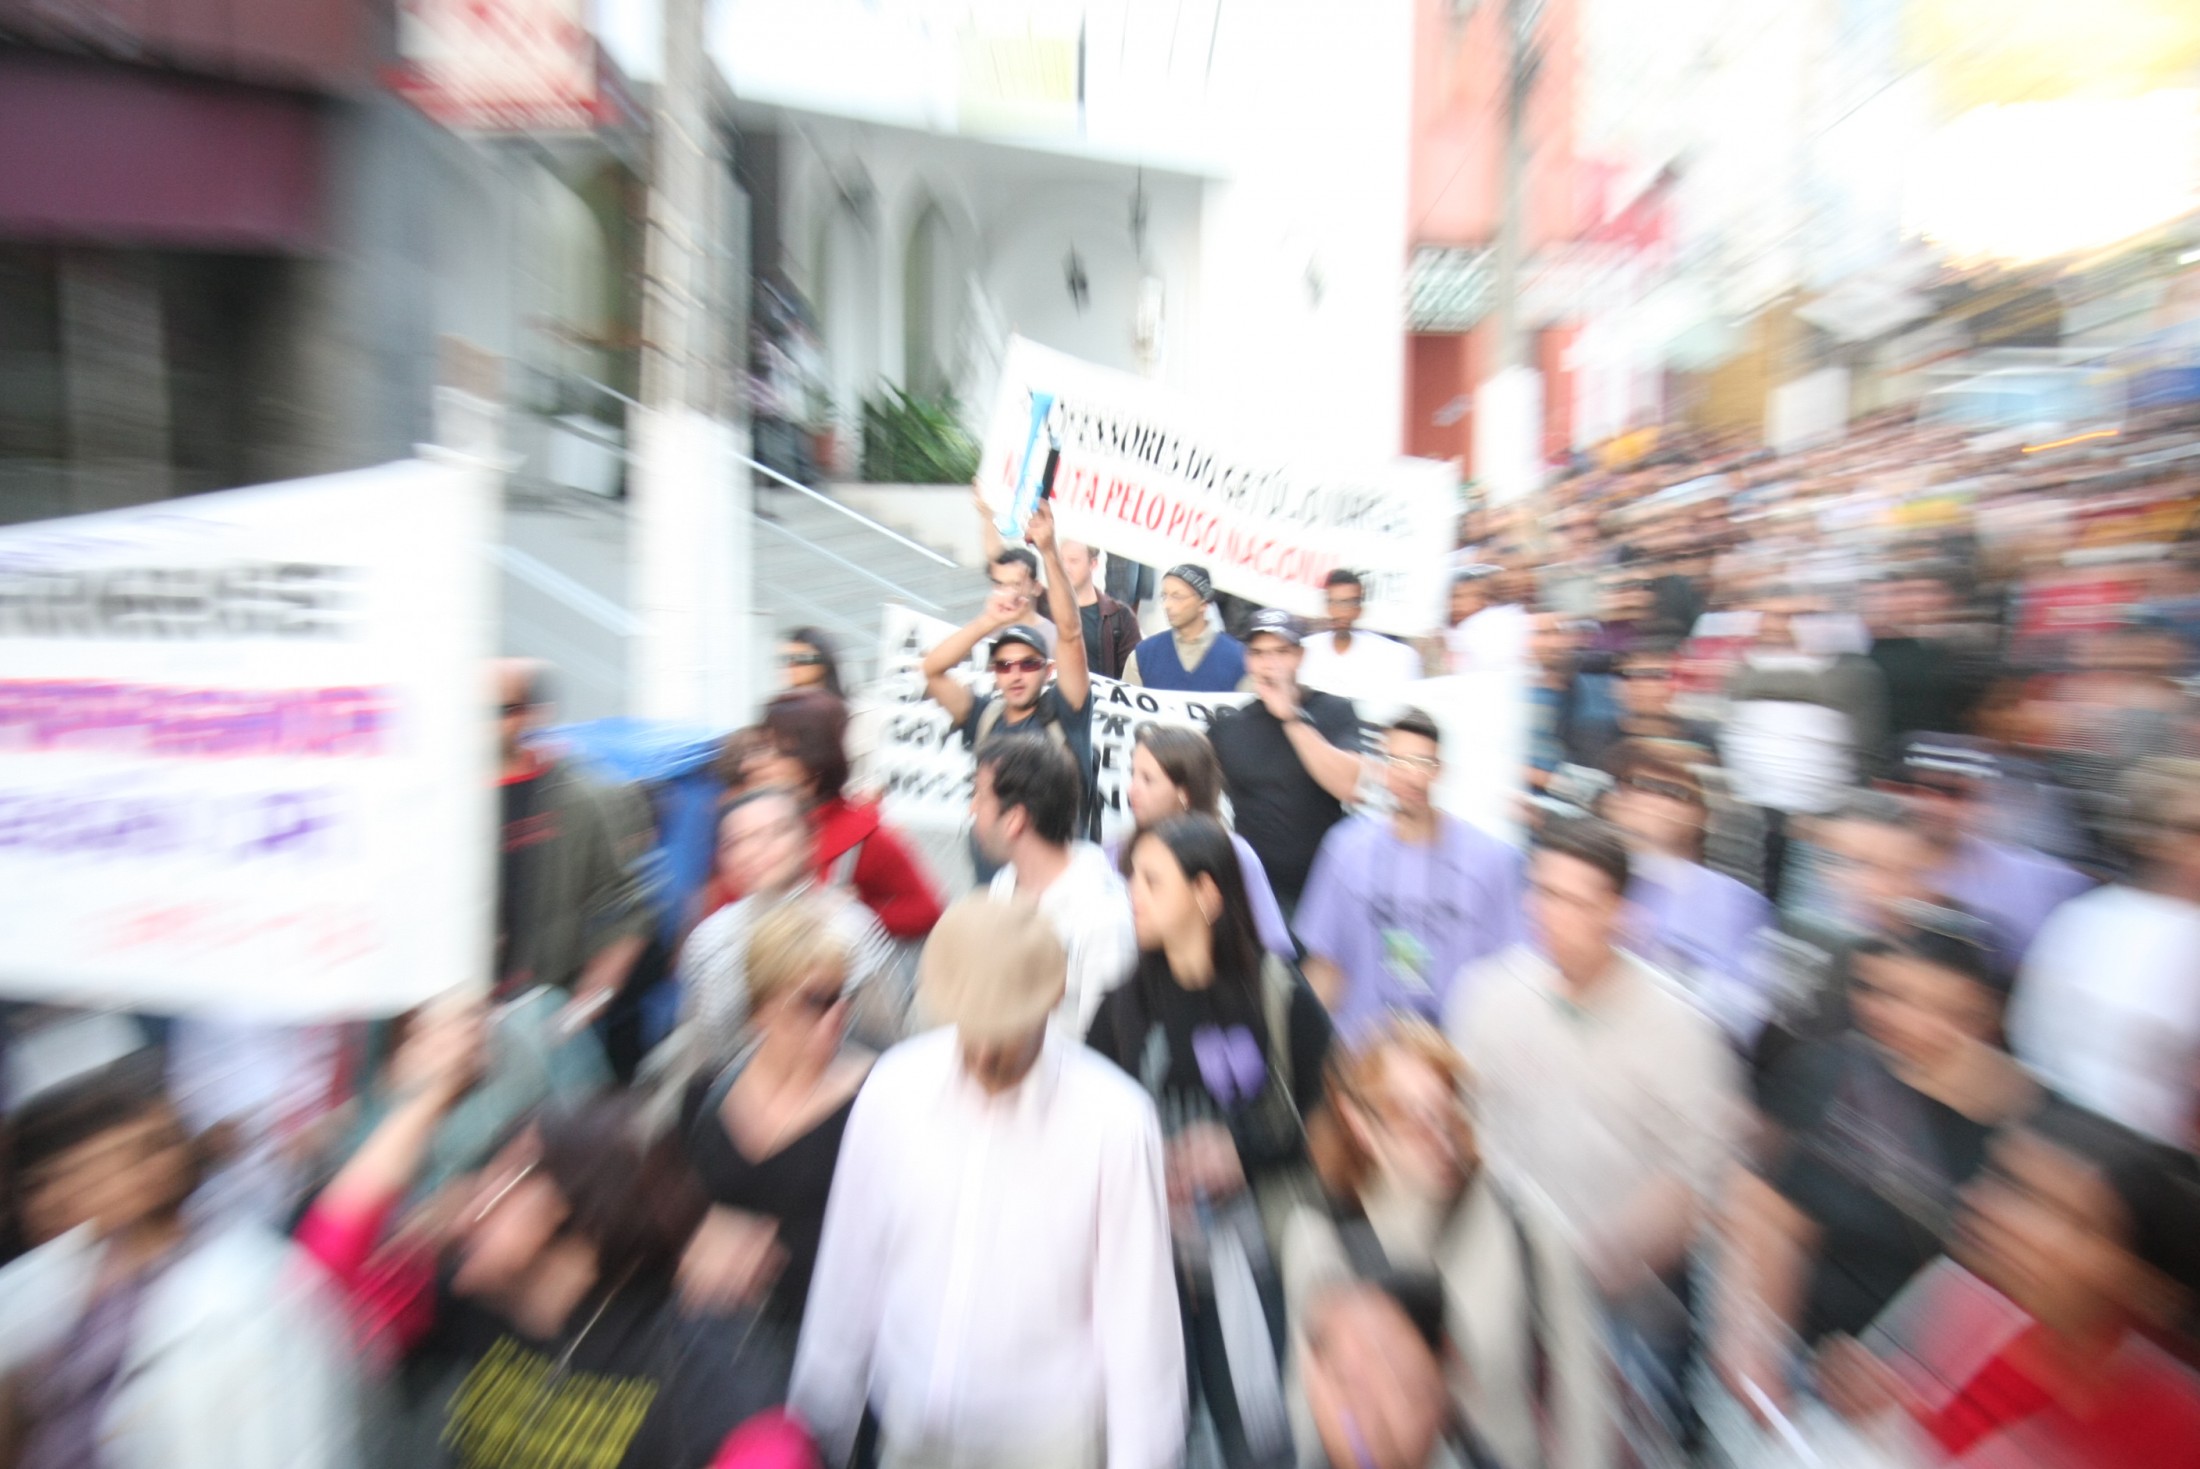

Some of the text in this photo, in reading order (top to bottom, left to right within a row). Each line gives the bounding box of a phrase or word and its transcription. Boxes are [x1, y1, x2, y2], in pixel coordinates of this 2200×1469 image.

[1026, 386, 1181, 474] OFESSORES
[1184, 443, 1219, 496] DO
[1102, 474, 1166, 531] PELO
[1166, 499, 1223, 556] PISO
